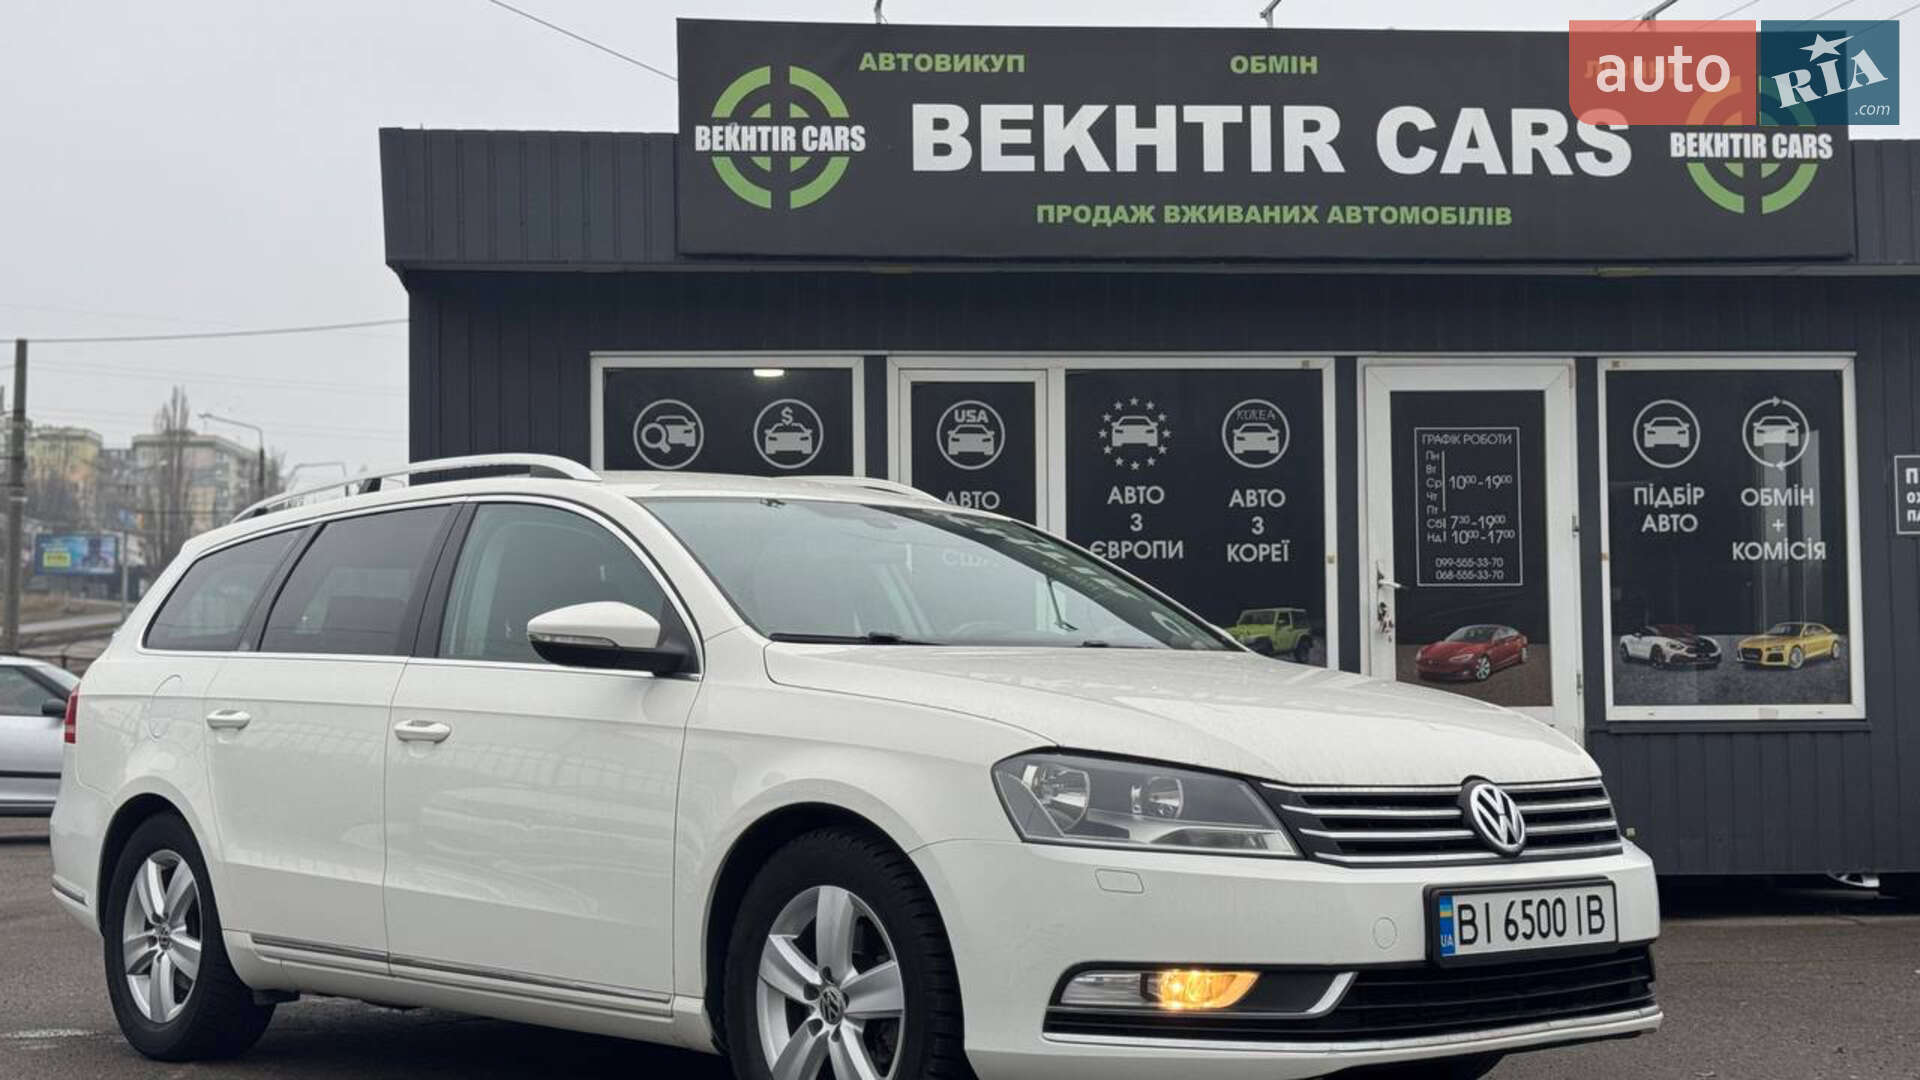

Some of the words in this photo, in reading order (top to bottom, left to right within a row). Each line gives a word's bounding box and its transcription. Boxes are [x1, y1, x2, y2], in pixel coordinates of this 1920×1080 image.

[859, 53, 1026, 73] АВТОВИКУП
[1230, 55, 1319, 75] ОБМІН
[695, 125, 797, 152] BEKHTIR
[802, 125, 866, 151] CARS
[912, 104, 1345, 173] BEKHTIR
[1376, 106, 1632, 177] CARS
[1670, 132, 1768, 159] BEKHTIR
[1772, 133, 1833, 160] CARS
[1037, 205, 1156, 227] ПРОДАЖ
[1164, 205, 1319, 225] ВЖИВАНИХ
[1327, 206, 1513, 227] АВТОМОБІЛІВ
[954, 409, 989, 424] USA
[1422, 434, 1461, 445] ГРАФІК
[1463, 434, 1512, 445] РОБОТИ
[945, 490, 1001, 510] АВТО
[1107, 486, 1165, 505] АВТО
[1228, 489, 1286, 508] АВТО
[1634, 483, 1705, 508] ПІДБІР
[1741, 485, 1814, 507] ОБМІН
[1641, 514, 1698, 533] АВТО
[1090, 541, 1184, 560] ЄВРОПИ
[1227, 539, 1290, 562] КОРЕЇ
[1732, 538, 1826, 560] КОМІСІЯ
[1457, 903, 1491, 945] BI
[1504, 897, 1567, 941] 6500
[1576, 894, 1605, 935] IB
[1440, 935, 1453, 947] UA
